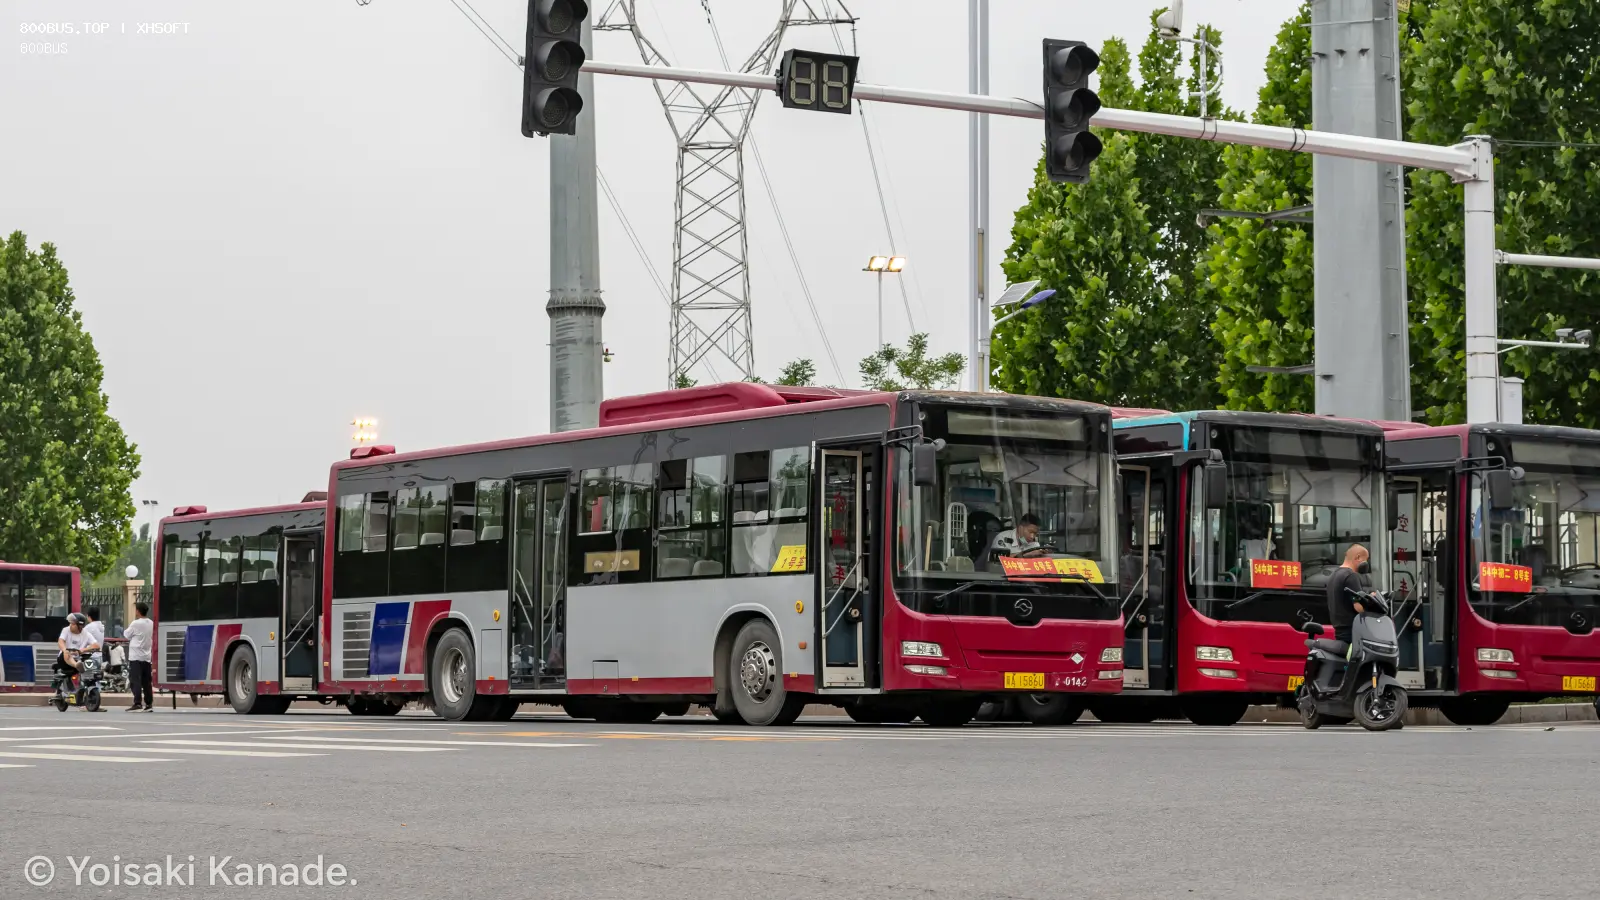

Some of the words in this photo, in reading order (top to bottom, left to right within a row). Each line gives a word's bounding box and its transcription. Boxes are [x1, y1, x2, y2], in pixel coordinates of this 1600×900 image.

[1033, 560, 1053, 571] 6号车
[1281, 565, 1299, 578] 7号车
[1514, 569, 1530, 582] 8号车
